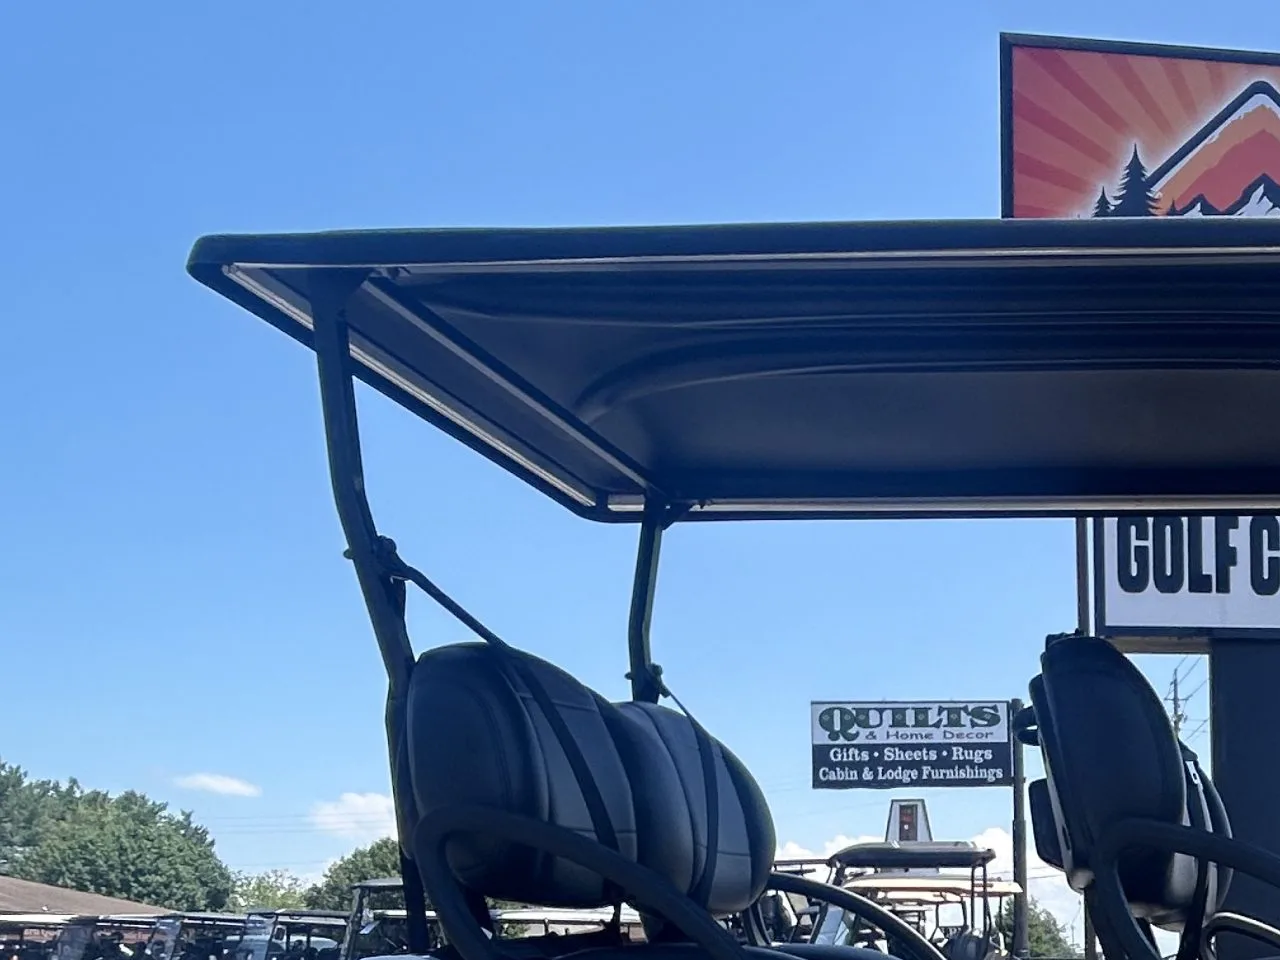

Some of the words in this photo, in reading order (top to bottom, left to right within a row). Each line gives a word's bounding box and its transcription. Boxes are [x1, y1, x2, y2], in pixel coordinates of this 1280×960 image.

[1116, 515, 1239, 594] GOLF
[818, 704, 1001, 742] QUILTS
[865, 730, 877, 740] &
[886, 729, 934, 740] Home
[943, 729, 994, 740] Decor
[829, 747, 870, 762] Gifts
[883, 746, 938, 761] Sheets
[952, 746, 993, 764] Rugs
[818, 766, 858, 781] Cabin
[862, 766, 874, 780] &
[877, 766, 919, 783] Lodge
[921, 764, 1004, 782] Furnishings
